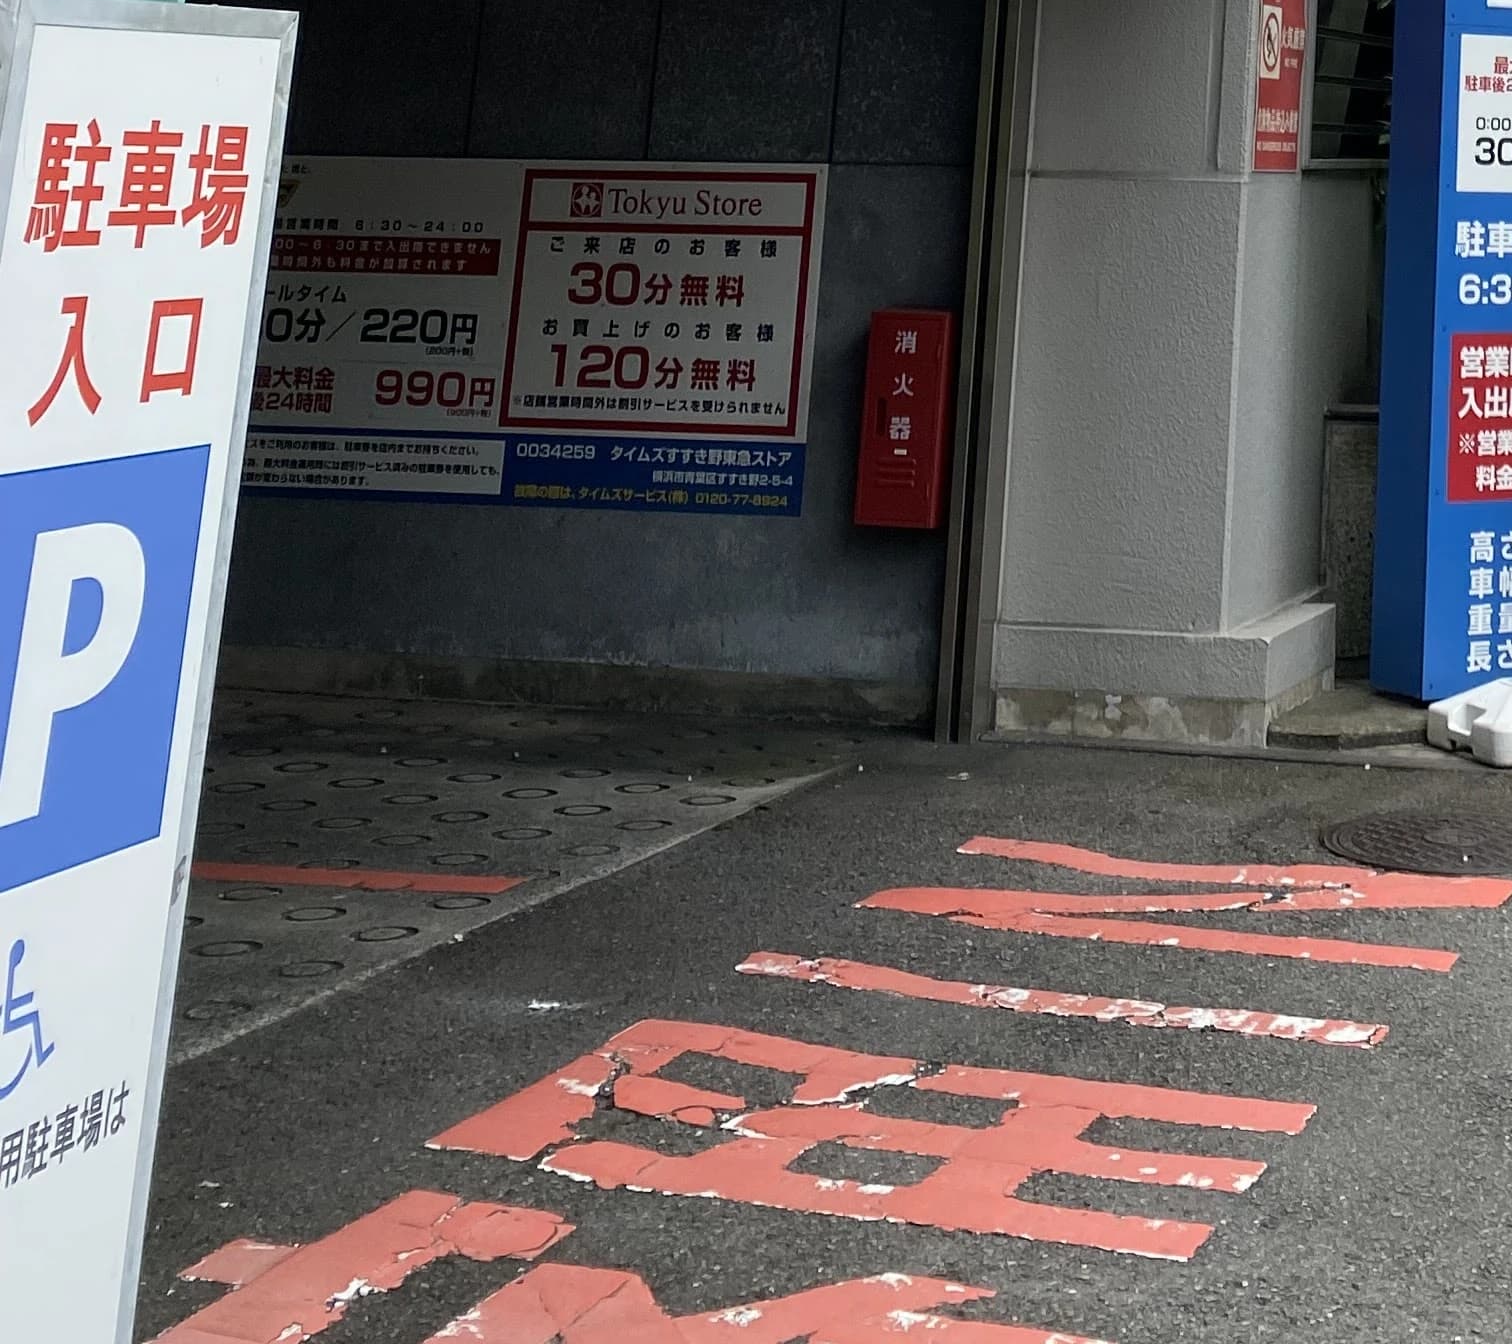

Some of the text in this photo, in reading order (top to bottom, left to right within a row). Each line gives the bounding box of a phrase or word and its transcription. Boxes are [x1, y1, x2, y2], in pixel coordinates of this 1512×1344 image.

[24, 118, 250, 252] 駐車場
[607, 188, 763, 219] Tokyu Store
[550, 236, 778, 259] ご来店のお客様
[567, 261, 745, 308] 30分無料
[542, 319, 775, 343] お買上げのお客様
[27, 295, 205, 428] 入口
[550, 343, 756, 392] 120分無料
[374, 369, 497, 408] 990円
[889, 330, 918, 441] 消火器
[517, 443, 595, 461] 0034259
[0, 521, 146, 828] P
